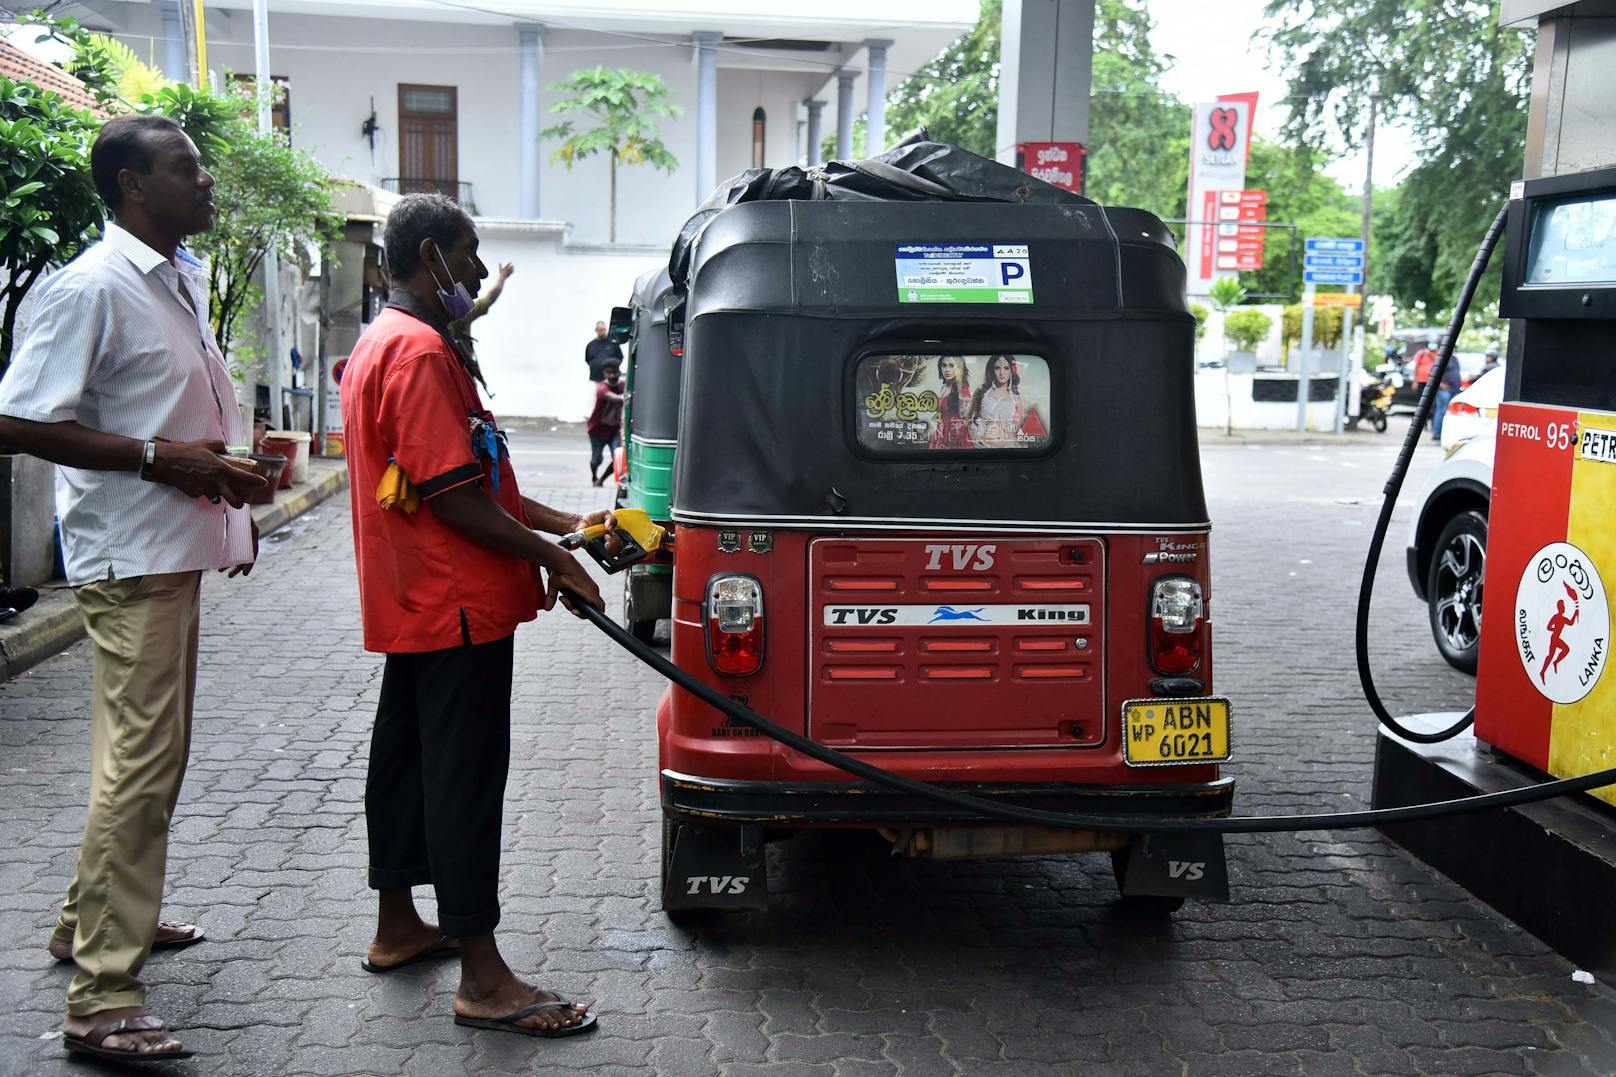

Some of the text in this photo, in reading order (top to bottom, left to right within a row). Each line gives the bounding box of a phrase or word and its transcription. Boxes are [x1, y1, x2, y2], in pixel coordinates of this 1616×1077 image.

[1000, 262, 1025, 286] P
[1501, 422, 1570, 450] PETROL 95
[723, 533, 736, 541] VIP
[753, 534, 767, 542] VIP
[924, 545, 996, 571] TVS
[831, 608, 898, 625] TVS
[1017, 608, 1086, 621] King
[1578, 637, 1604, 687] LANKA
[1163, 705, 1212, 730] ABN
[1132, 724, 1155, 742] WP
[1159, 732, 1213, 758] 6021
[1168, 860, 1206, 880] VS
[686, 876, 750, 895] TVS
